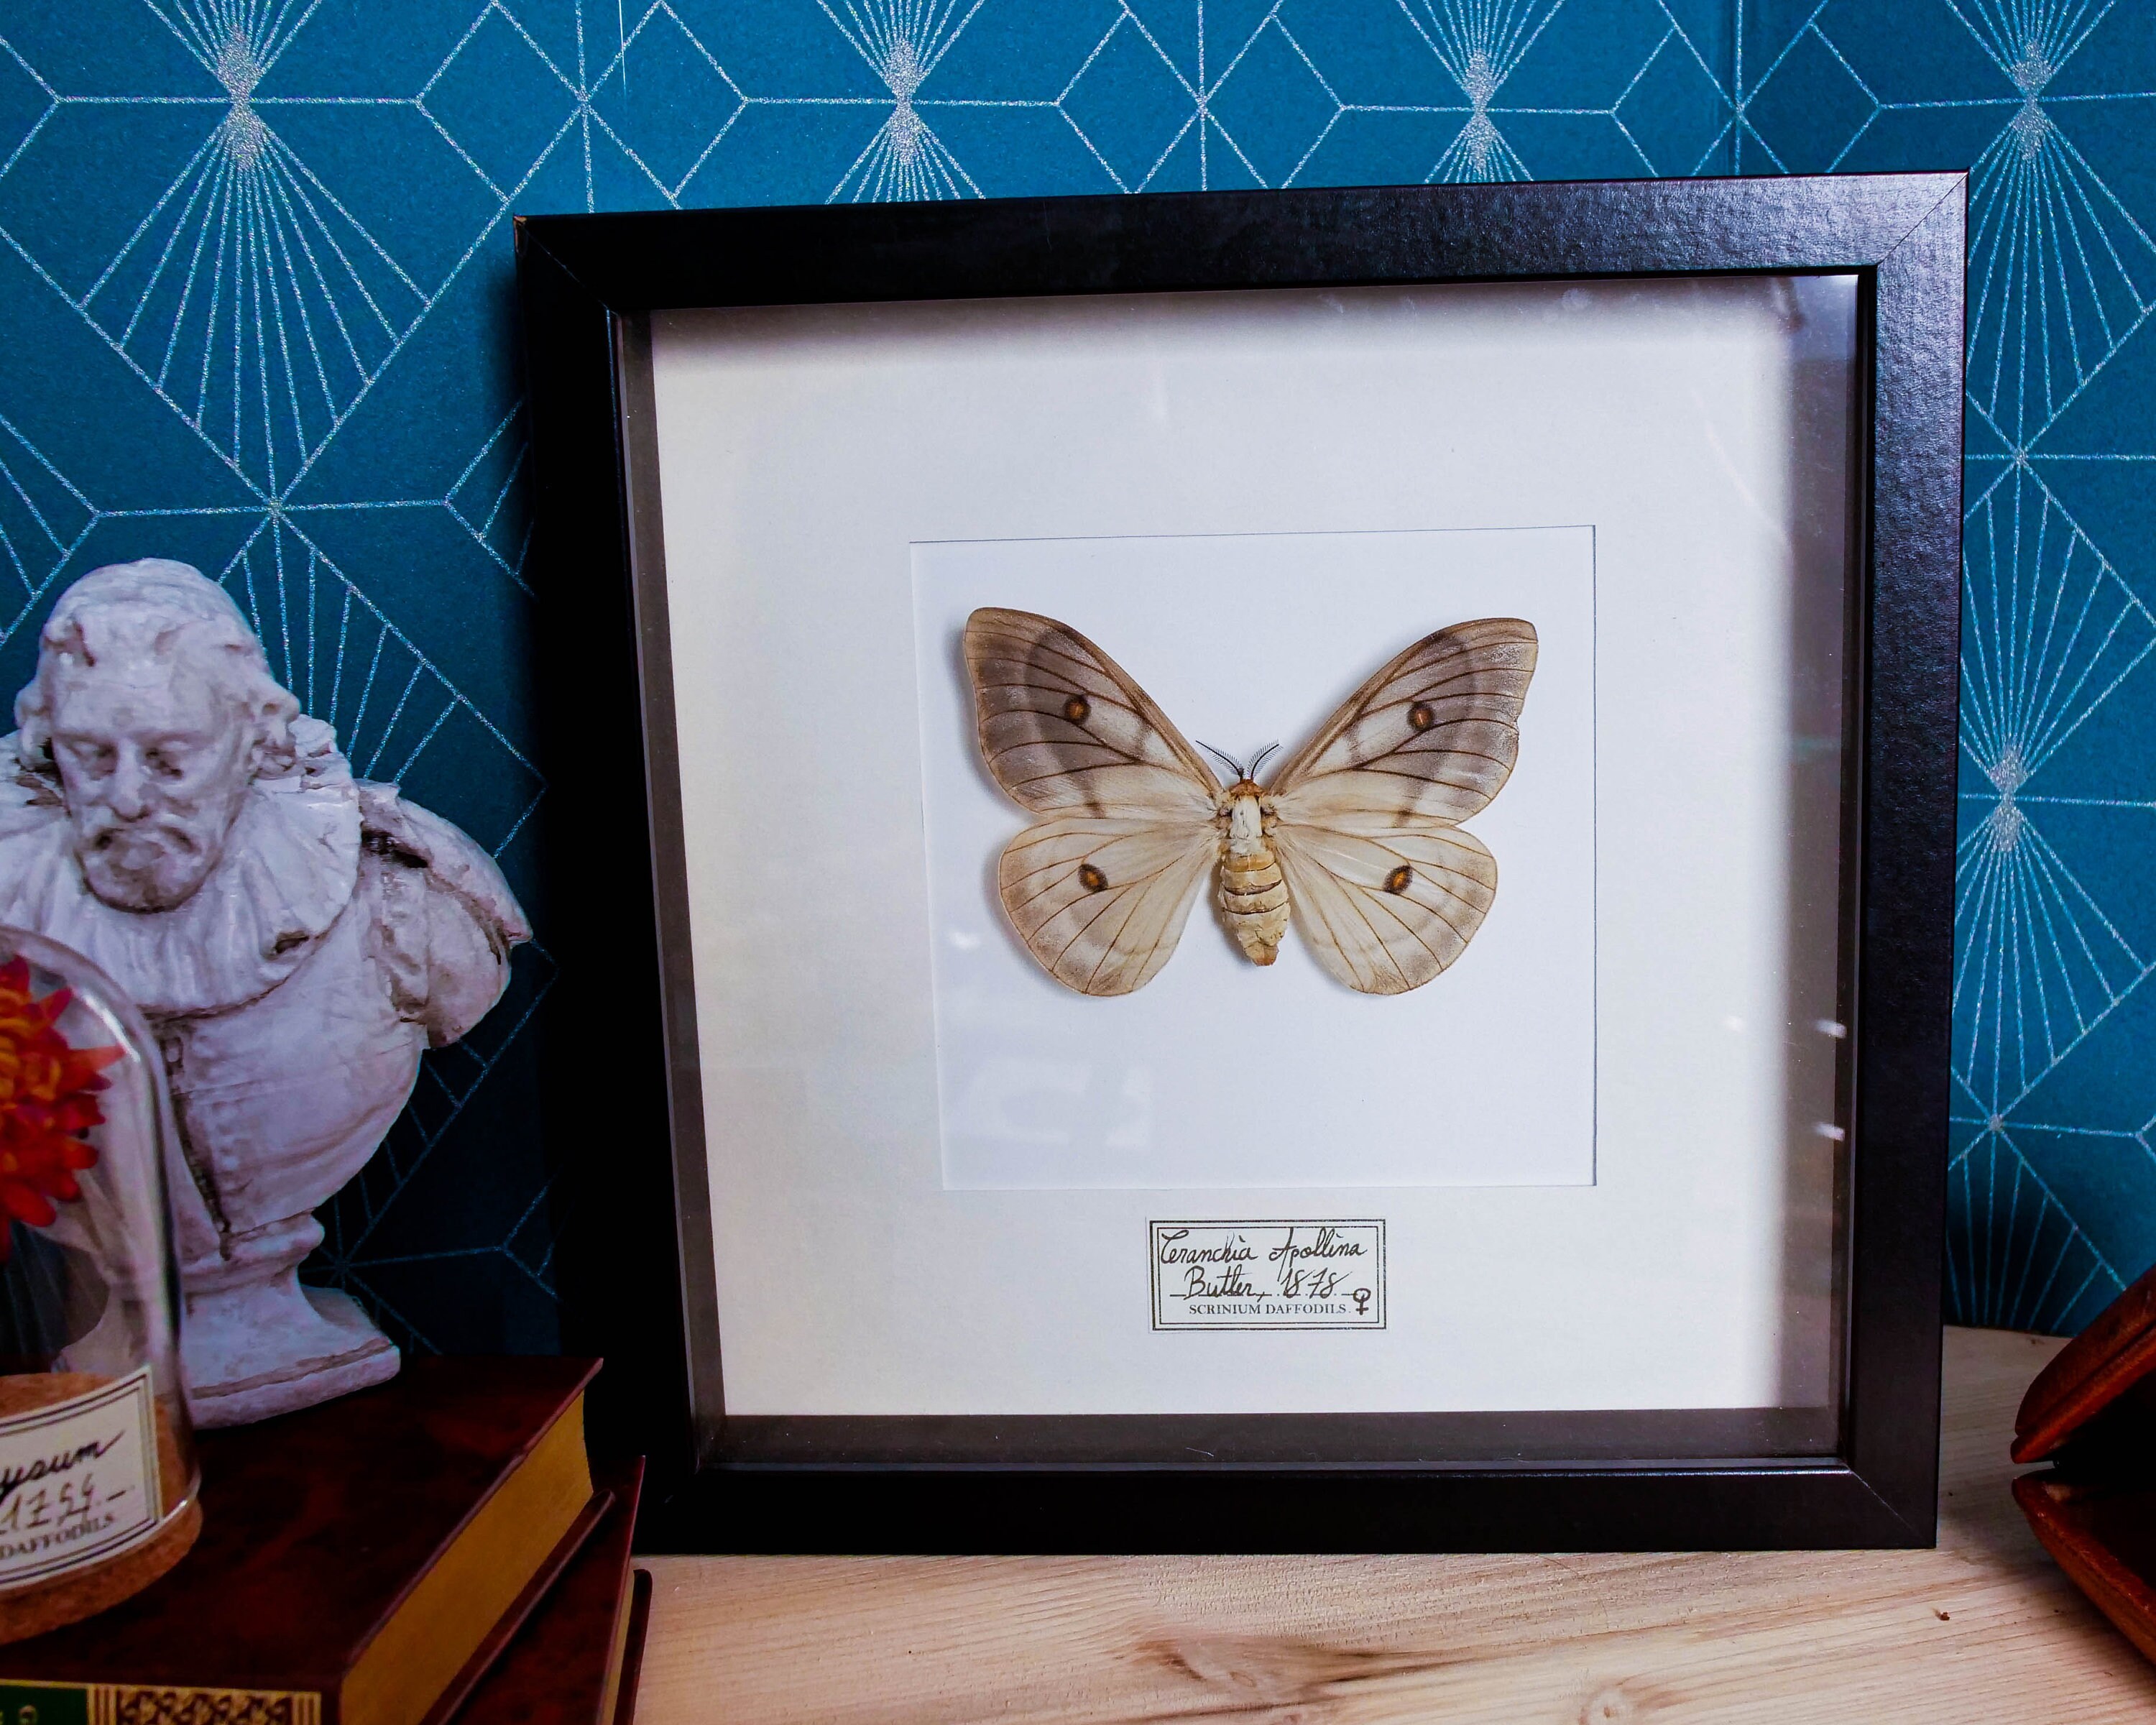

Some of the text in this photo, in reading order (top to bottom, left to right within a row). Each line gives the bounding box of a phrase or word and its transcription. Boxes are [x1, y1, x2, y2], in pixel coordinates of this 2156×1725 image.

[1268, 1225, 1367, 1282] Apollina
[1184, 1264, 1353, 1302] Butler, 1878
[1189, 1304, 1261, 1315] SCRINIUM
